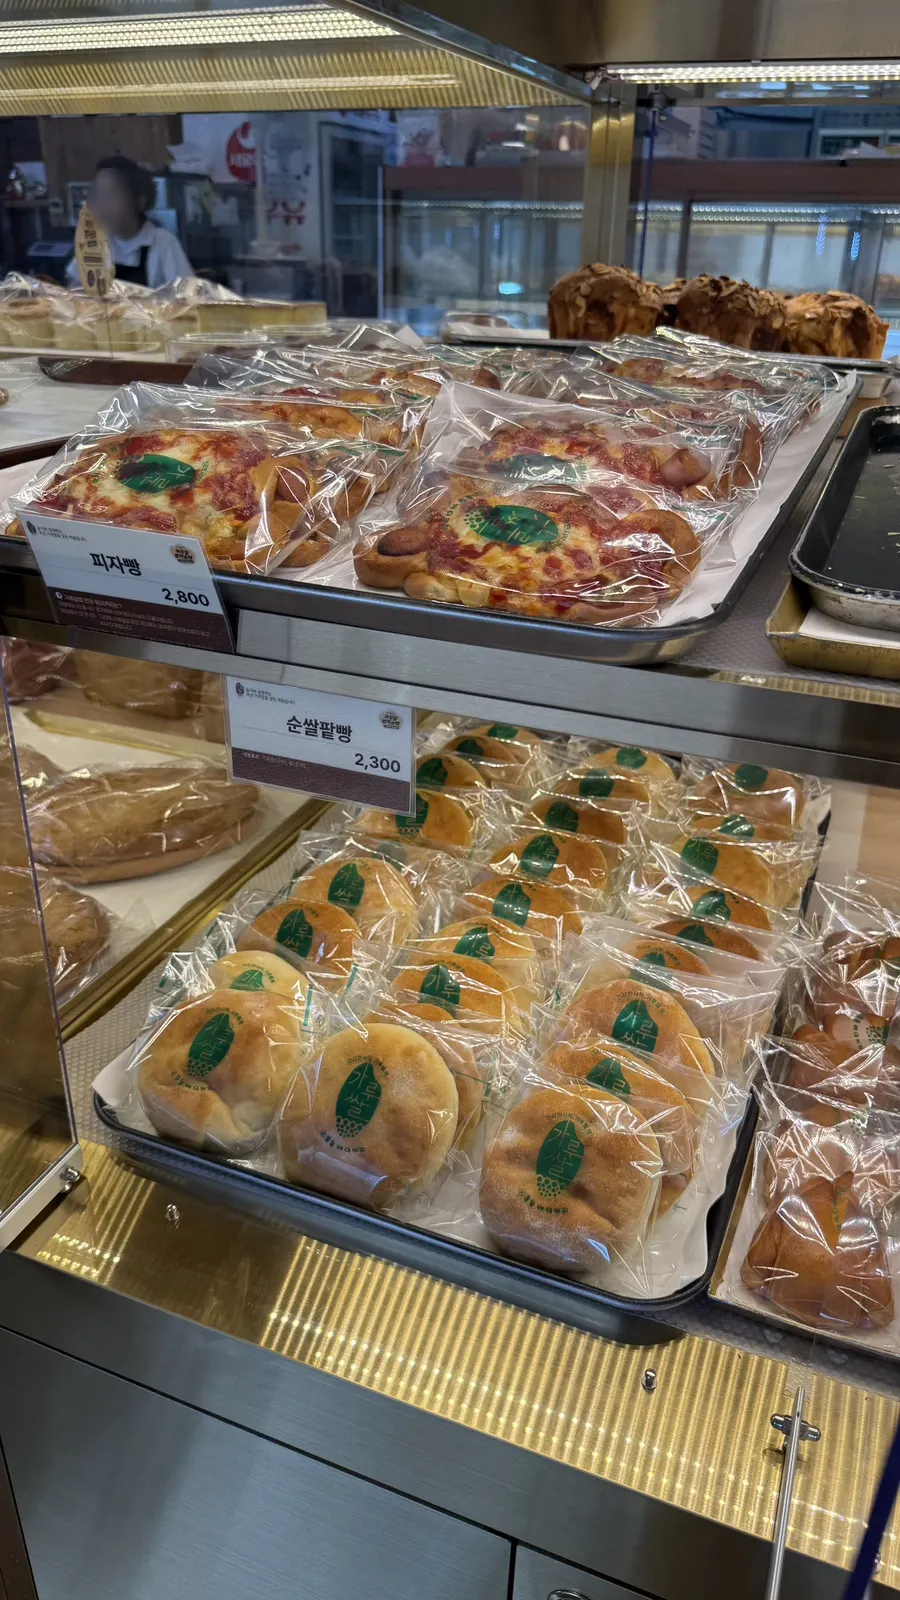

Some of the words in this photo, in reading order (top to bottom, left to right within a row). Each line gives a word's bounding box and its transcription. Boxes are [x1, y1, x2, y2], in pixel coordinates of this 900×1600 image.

[89, 552, 142, 577] 피자빵
[161, 587, 211, 607] 2,800
[286, 715, 353, 744] 순쌀팥빵
[354, 752, 402, 774] 2,300
[197, 1012, 234, 1064] 가루쌀
[343, 1062, 381, 1123] 가루쌀
[544, 1119, 585, 1182] 가루쌀
